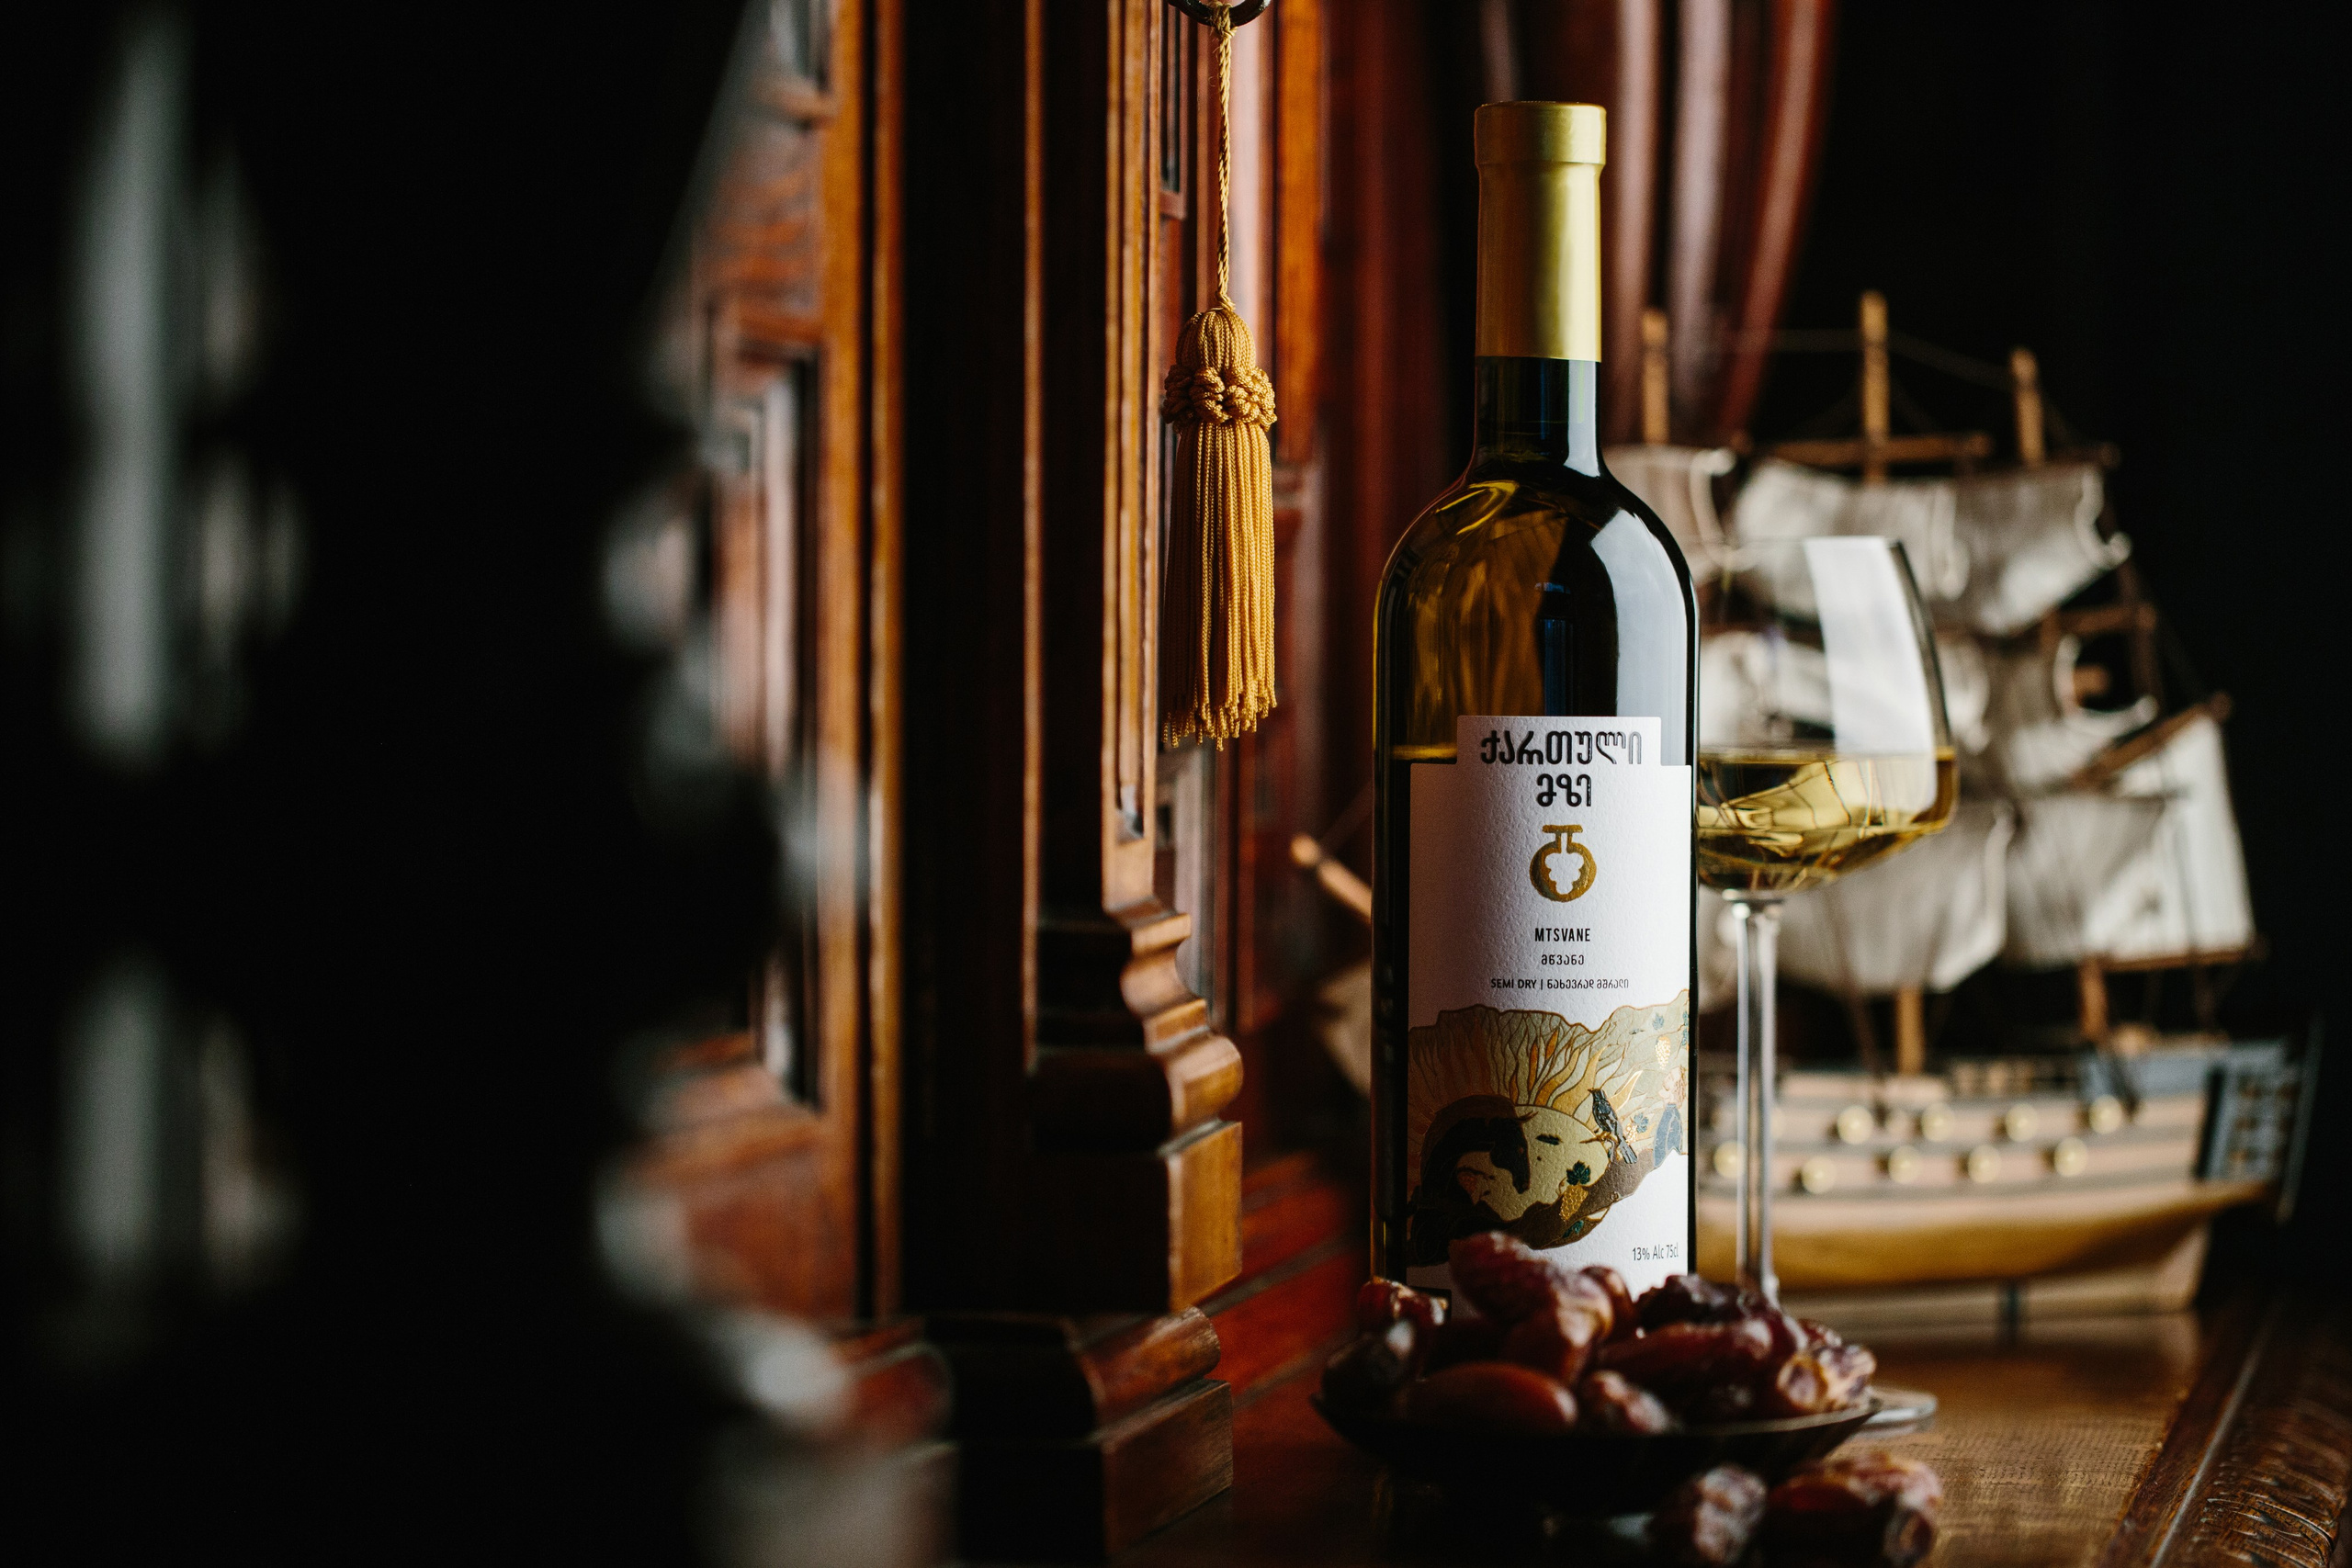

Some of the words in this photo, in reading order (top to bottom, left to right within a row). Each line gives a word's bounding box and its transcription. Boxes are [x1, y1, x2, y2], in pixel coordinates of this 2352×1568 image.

[1480, 730, 1642, 764] ქართული
[1536, 773, 1592, 807] მზე
[1534, 928, 1590, 942] MTSVANE
[1541, 954, 1585, 965] მწვანე
[1490, 978, 1514, 989] SEMI
[1518, 978, 1537, 989] DRY
[1546, 978, 1594, 989] ნახევრად
[1596, 978, 1629, 989] მშრალი
[1632, 1247, 1650, 1261] 13%
[1653, 1244, 1664, 1259] Alc
[1666, 1242, 1679, 1258] 75cl
